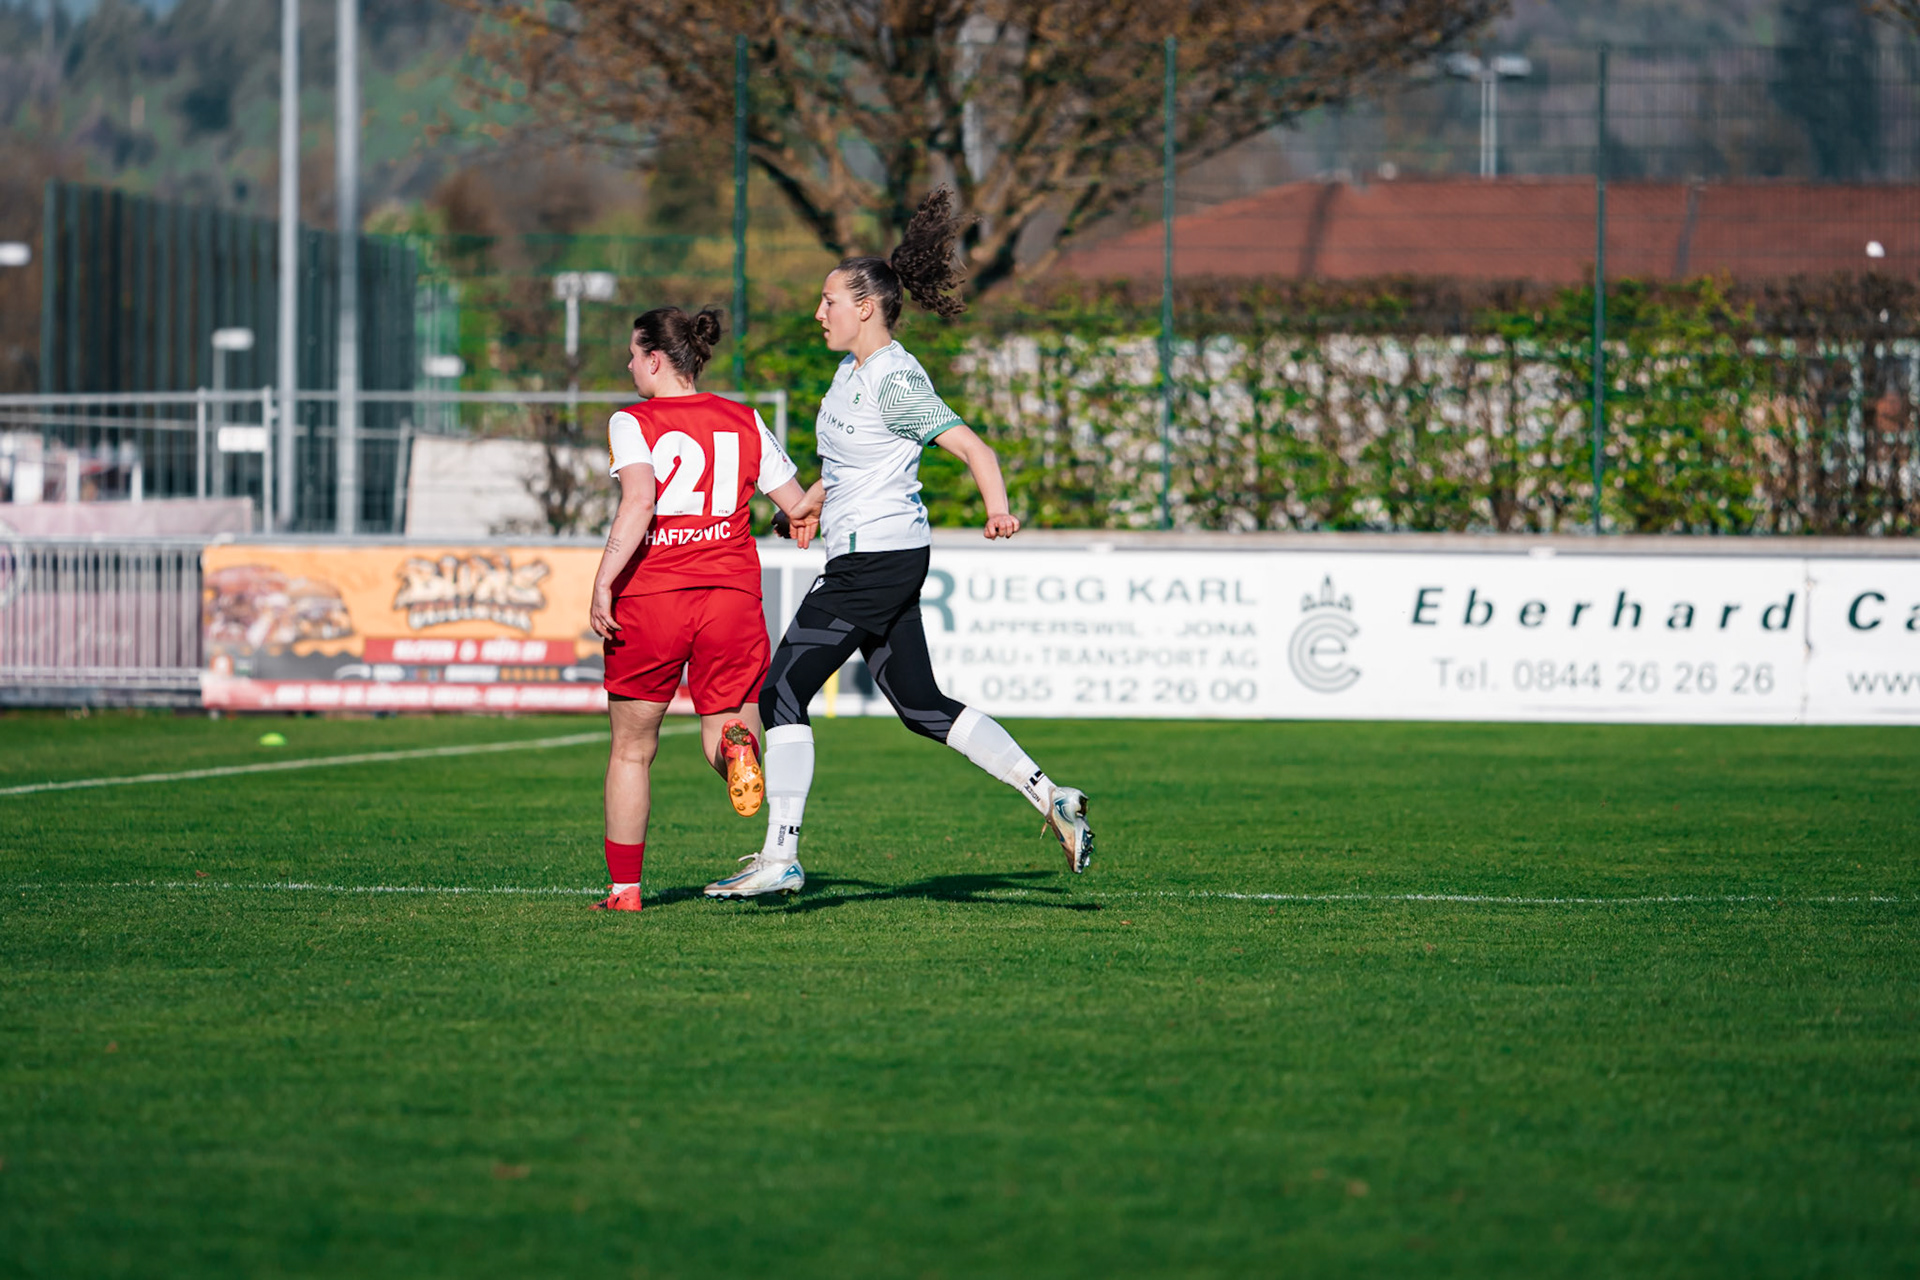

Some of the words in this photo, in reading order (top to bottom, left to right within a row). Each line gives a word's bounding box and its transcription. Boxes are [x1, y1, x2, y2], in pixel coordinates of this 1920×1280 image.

[651, 431, 739, 516] 21
[644, 521, 731, 545] HAFIZOVIC
[1127, 576, 1258, 605] KARL
[1409, 586, 1796, 632] Eberhard
[1175, 620, 1257, 638] JONA
[1218, 648, 1259, 669] AG
[981, 676, 1054, 702] 055
[1074, 677, 1140, 703] 212
[1152, 677, 1198, 704] 26
[1208, 677, 1258, 704] 00
[1431, 657, 1499, 691] Tel.
[1511, 658, 1601, 693] 0844
[1615, 660, 1660, 694] 26
[1673, 661, 1718, 695] 26
[1731, 661, 1776, 695] 26
[1846, 670, 1920, 694] ww
